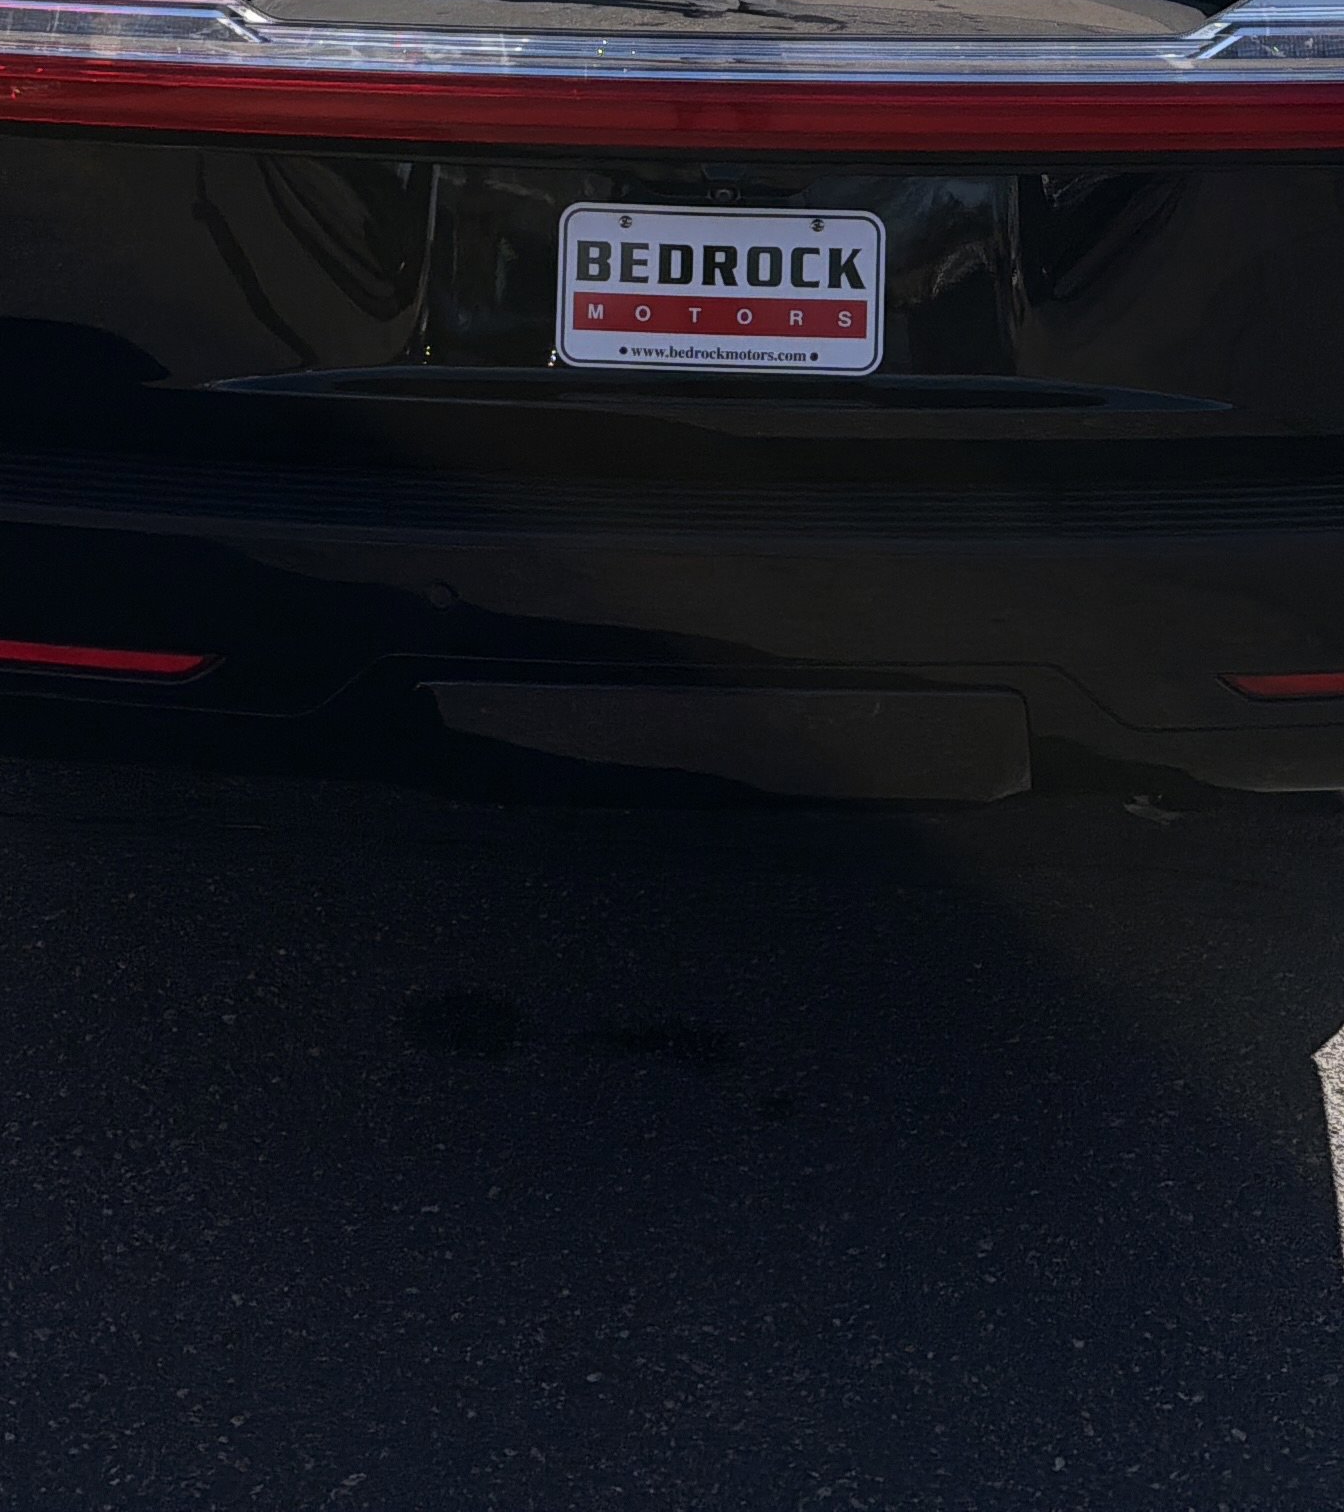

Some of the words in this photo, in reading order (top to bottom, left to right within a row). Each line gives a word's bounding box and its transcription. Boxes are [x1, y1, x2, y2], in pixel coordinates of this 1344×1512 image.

[575, 239, 867, 290] BEDROCK
[587, 302, 853, 329] MOTORS
[631, 344, 807, 363] www.bedrockmotors.com
